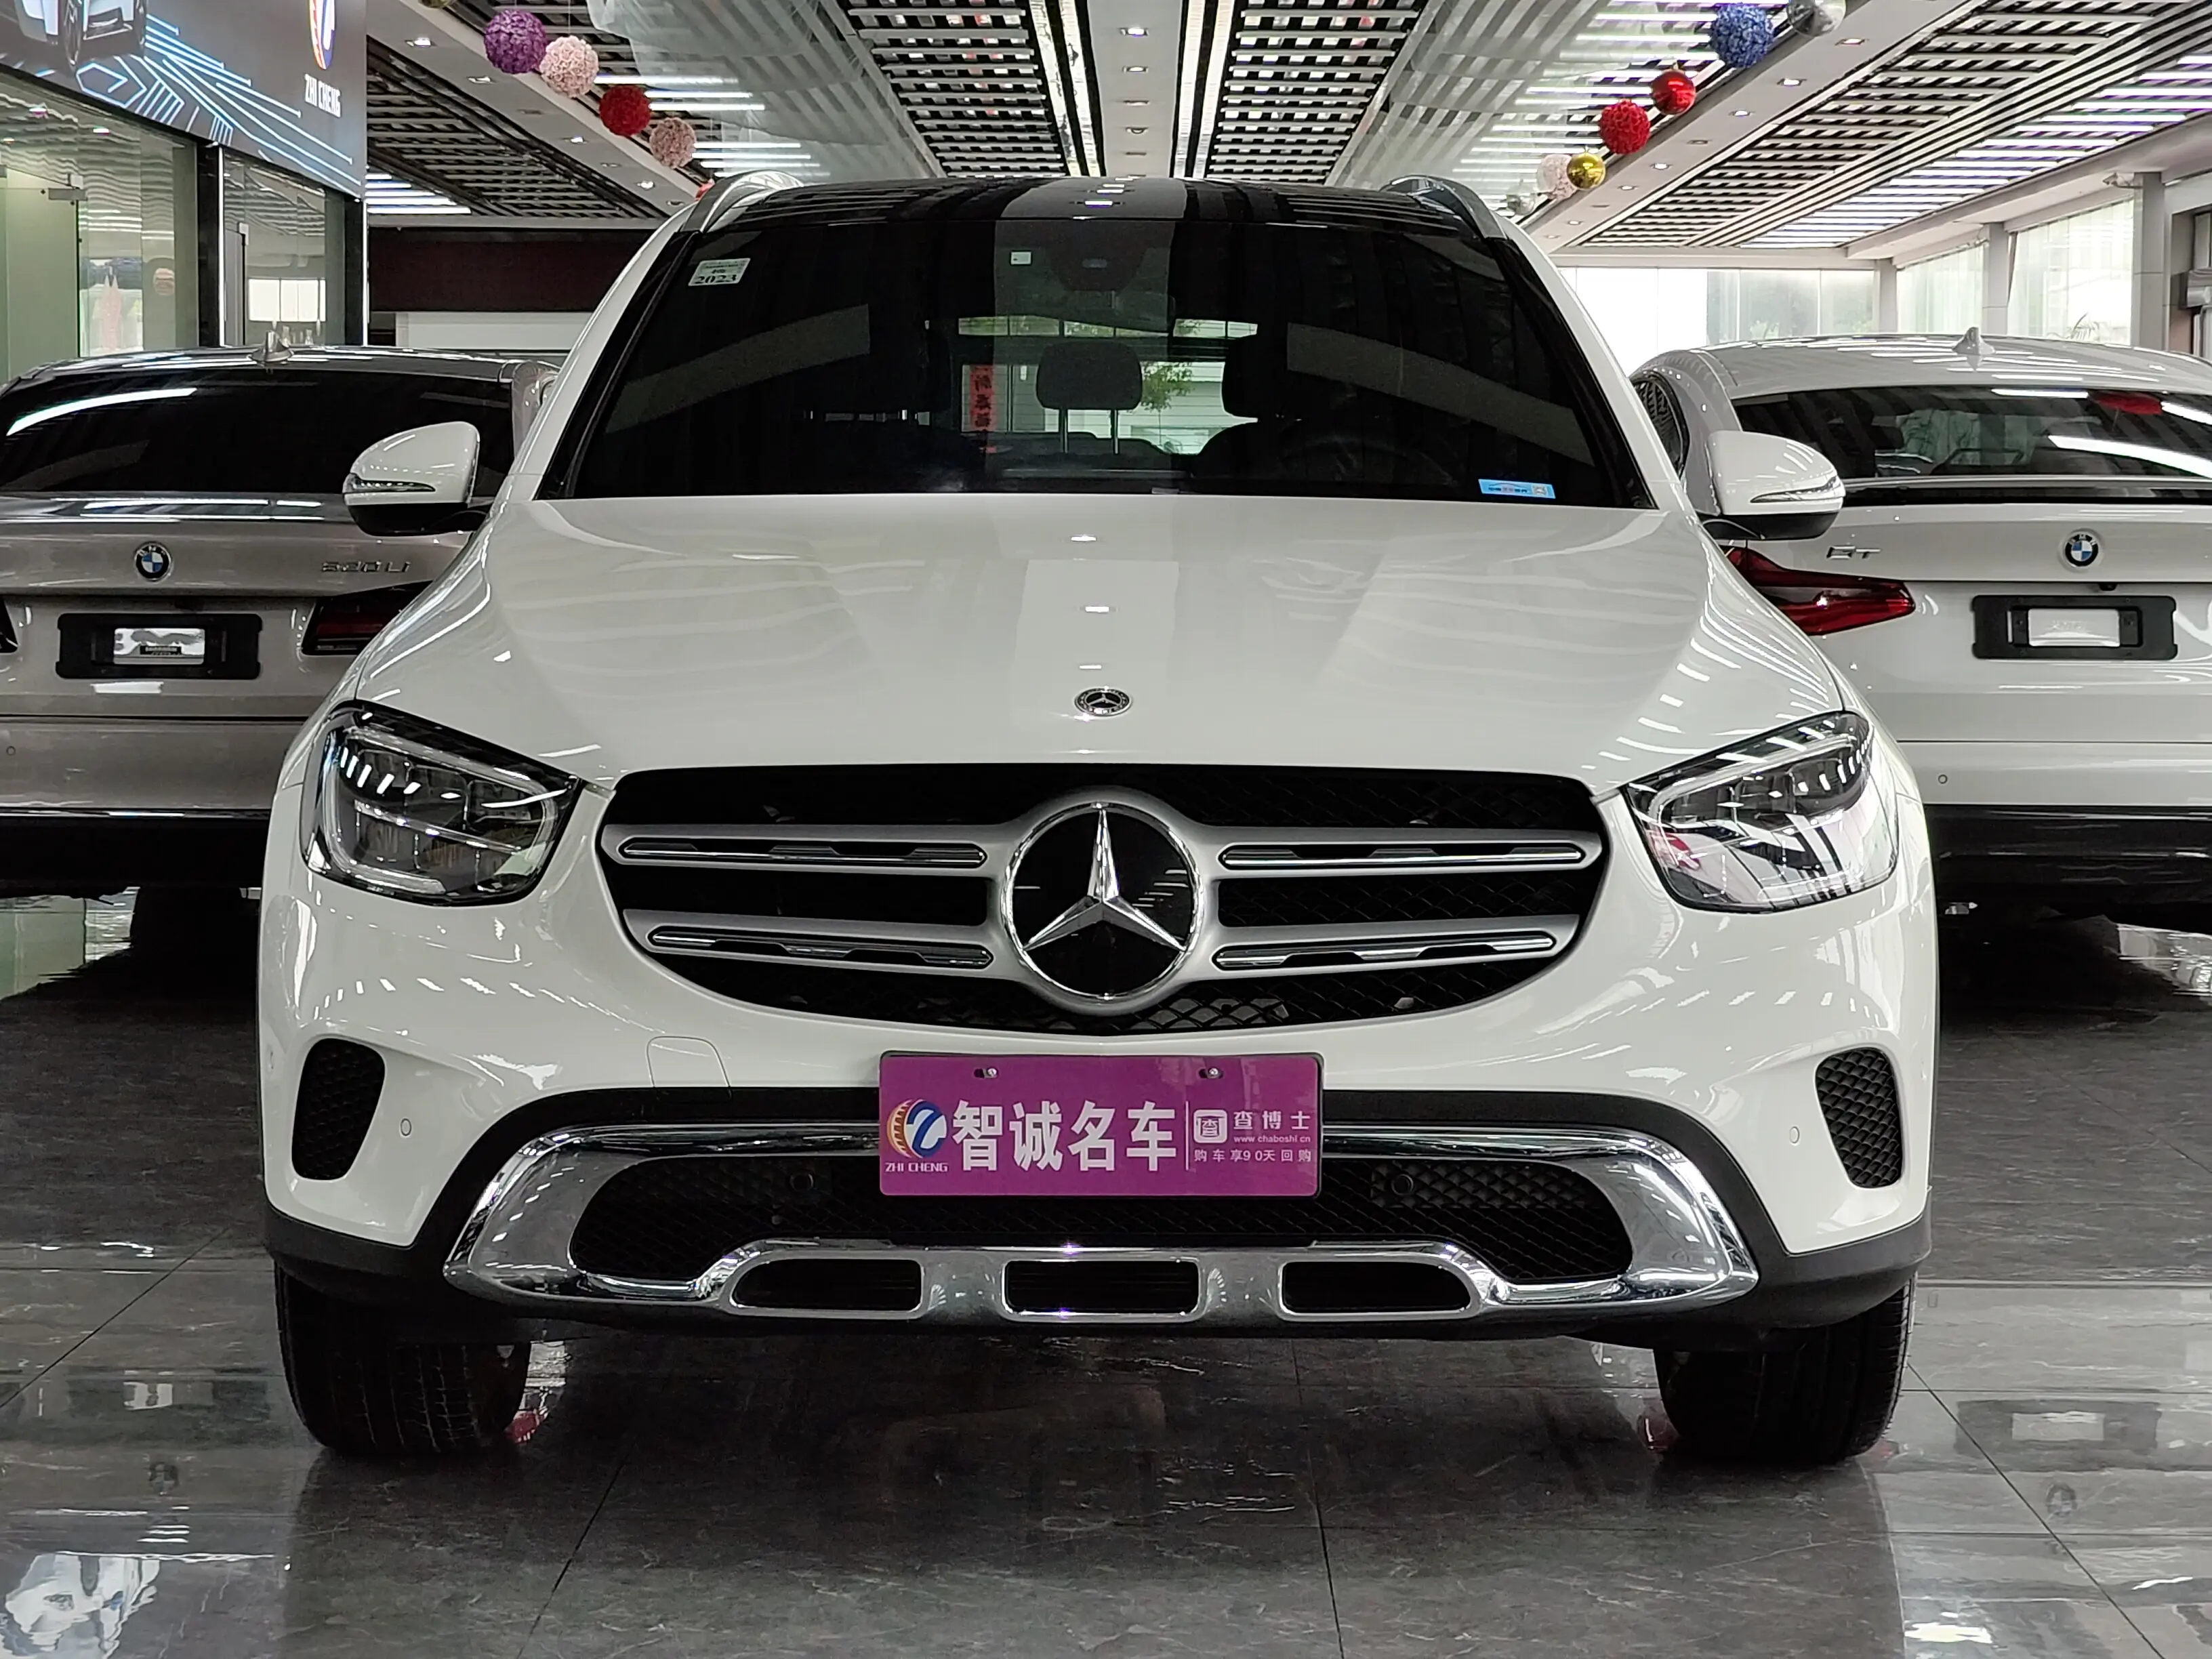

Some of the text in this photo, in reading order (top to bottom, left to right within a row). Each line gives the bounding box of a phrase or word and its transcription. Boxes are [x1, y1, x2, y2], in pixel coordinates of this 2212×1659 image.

[305, 73, 341, 118] ZHI CHENG
[951, 1099, 1177, 1172] 智诚名车
[1233, 1110, 1311, 1130] 查博士
[885, 1162, 949, 1172] ZHI CHENG
